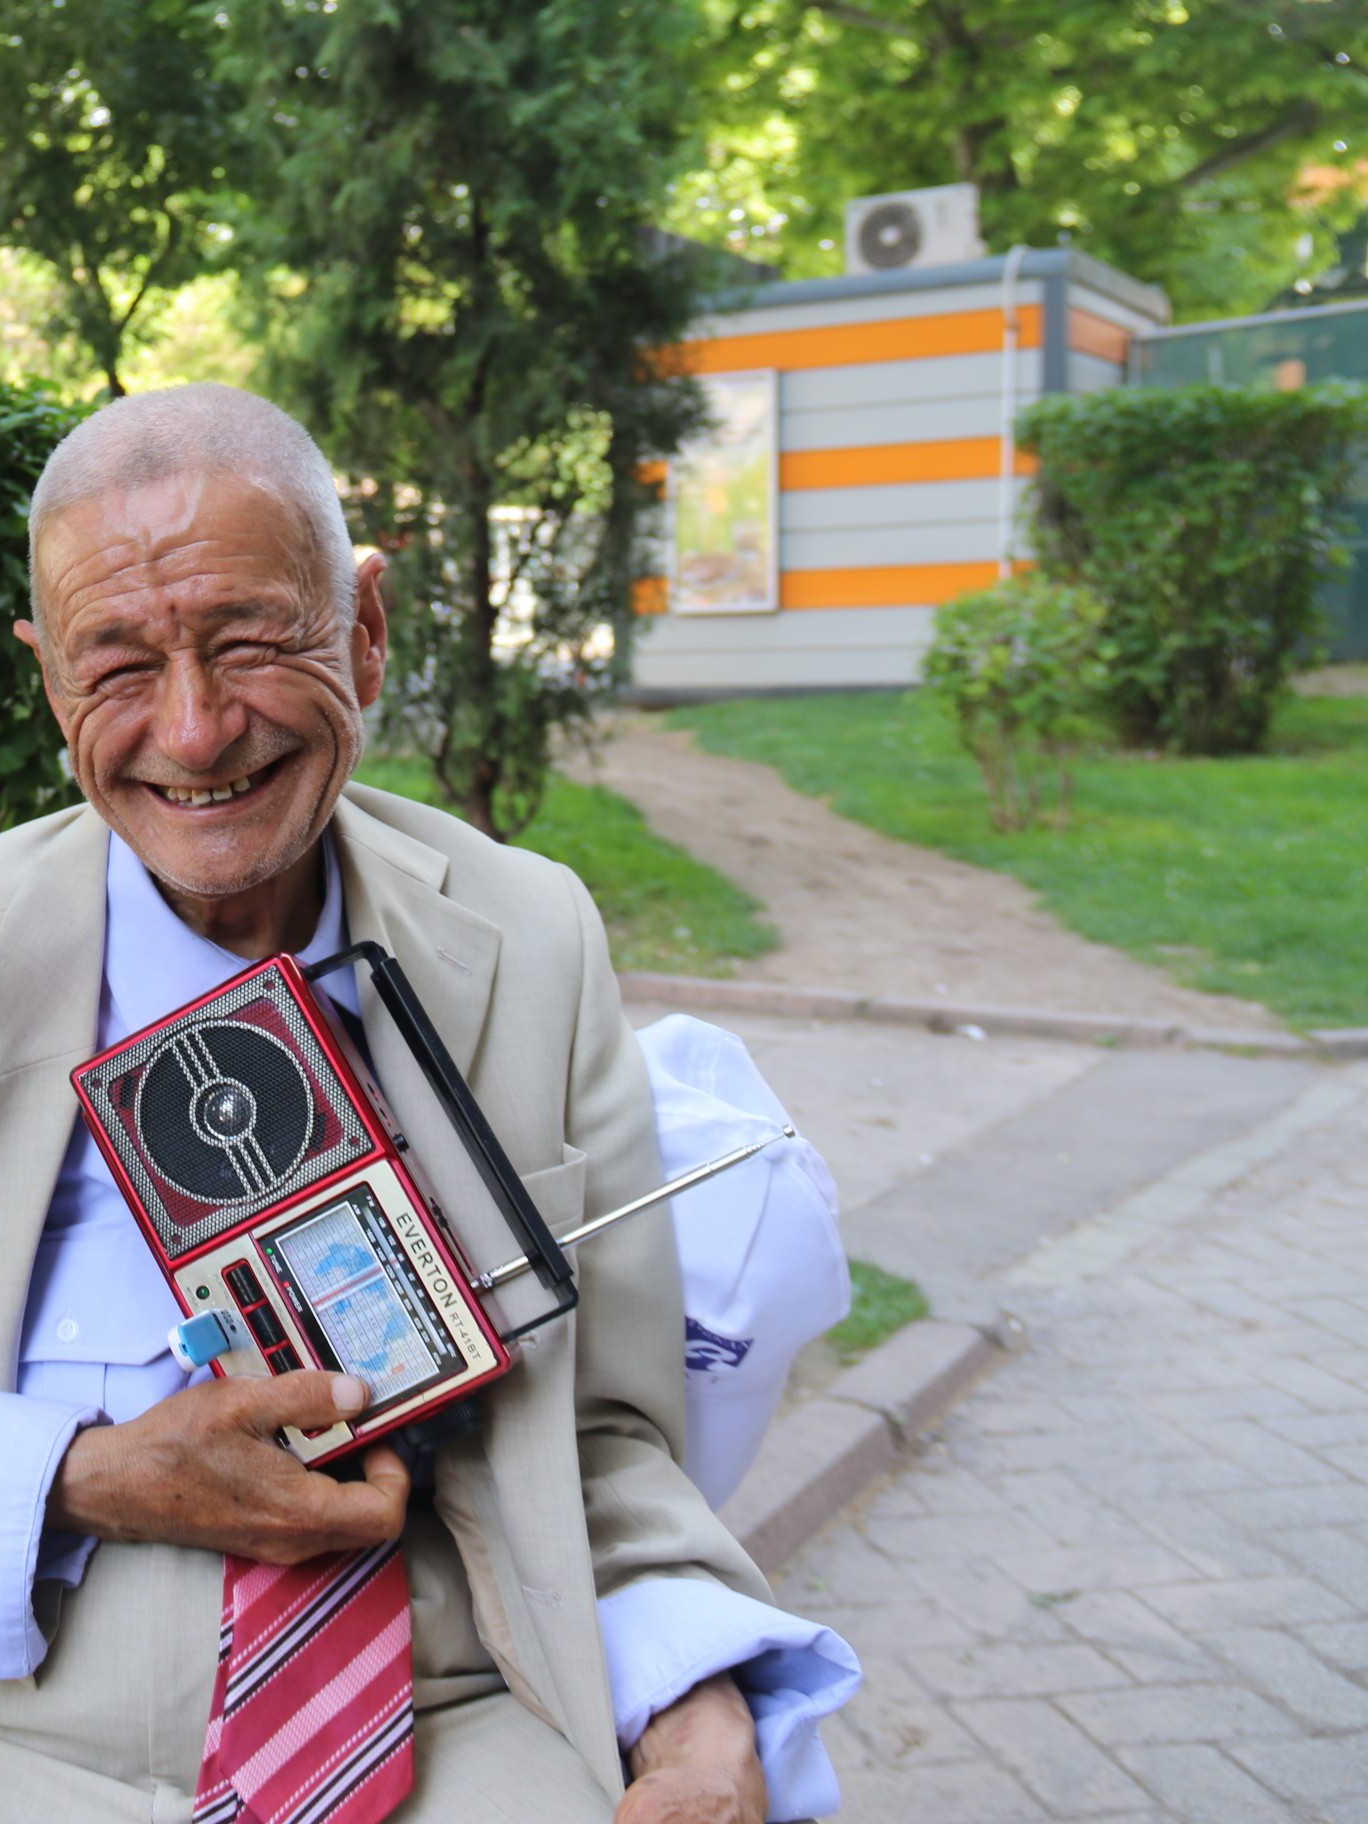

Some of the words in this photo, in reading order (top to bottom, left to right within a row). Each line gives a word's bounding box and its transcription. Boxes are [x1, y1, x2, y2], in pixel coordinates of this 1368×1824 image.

[269, 1254, 282, 1273] TUNE
[285, 1286, 303, 1313] POWER
[395, 1211, 457, 1308] EVERTON
[449, 1311, 481, 1361] RT-41BT
